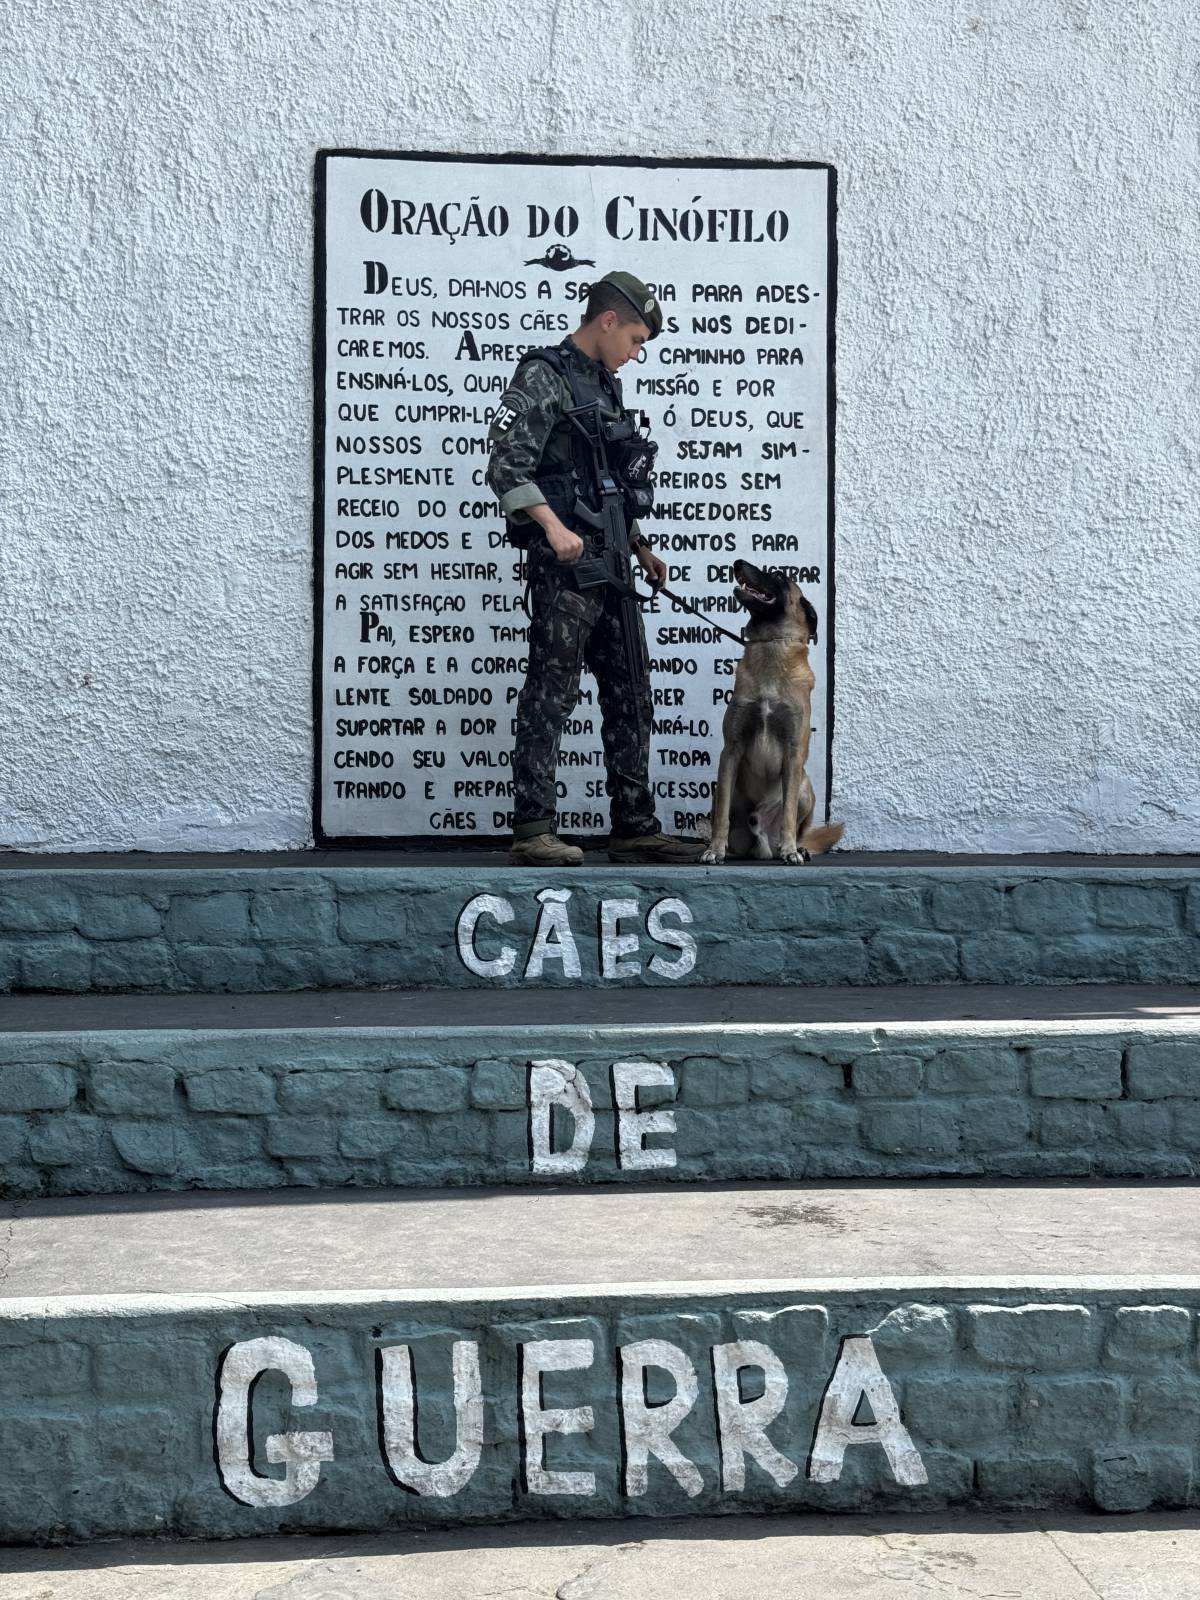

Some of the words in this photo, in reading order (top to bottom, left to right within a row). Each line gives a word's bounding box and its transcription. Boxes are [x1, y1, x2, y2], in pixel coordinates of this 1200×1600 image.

[360, 188, 509, 245] ORAÇÃO
[527, 204, 579, 238] DO
[605, 195, 789, 242] CINÓFILO
[363, 261, 438, 299] DEUS,
[449, 279, 526, 299] DAI-NOS
[538, 280, 551, 299] A
[692, 284, 742, 303] PARA
[756, 284, 820, 304] ADES-
[337, 308, 385, 326] TRAR
[397, 310, 420, 327] OS
[432, 311, 510, 329] NOSSOS
[520, 310, 568, 331] CÃES
[693, 317, 732, 334] NOS
[746, 317, 807, 334] DEDI-
[337, 340, 430, 360] CAREMOS.
[660, 347, 745, 365] CAMINHO
[757, 347, 804, 365] PARA
[337, 367, 454, 396] ENSINÁ-LOS,
[636, 372, 700, 396] MISSÃO
[713, 379, 722, 396] E
[737, 379, 775, 397] POR
[338, 403, 379, 422] QUE
[663, 404, 676, 427] Ó
[691, 407, 754, 432] DEUS,
[767, 410, 804, 429] QUE
[493, 405, 517, 431] PE
[336, 436, 422, 455] NOSSOS
[677, 440, 742, 460] SEJAM
[761, 442, 810, 460] SIM-
[336, 466, 455, 486] PLESMENTE
[741, 472, 781, 490] SEM
[338, 499, 400, 517] RECEIO
[418, 500, 446, 517] DO
[336, 531, 375, 549] DOS
[386, 532, 449, 550] MEDOS
[462, 532, 472, 549] E
[648, 533, 737, 552] PRONTOS
[752, 533, 799, 552] PARA
[336, 563, 373, 580] AGIR
[383, 563, 418, 580] SEM
[431, 562, 503, 584] HESITAR,
[669, 565, 692, 582] DE
[336, 594, 347, 611] A
[360, 612, 396, 647] PAI,
[409, 625, 474, 643] ESPERO
[656, 626, 722, 645] SENHOR
[334, 656, 346, 673] A
[358, 656, 415, 679] FORÇA
[427, 657, 437, 673] E
[447, 657, 458, 673] A
[336, 687, 390, 707] LENTE
[409, 687, 493, 706] SOLDADO
[335, 718, 425, 737] SUPORTAR
[436, 719, 447, 735] A
[460, 718, 497, 736] DOR
[334, 750, 394, 769] CENDO
[413, 750, 445, 769] SEU
[657, 749, 711, 767] TROPA
[334, 781, 406, 800] TRANDO
[425, 781, 435, 799] E
[455, 887, 698, 980] CÃES
[526, 1059, 677, 1175] DE
[212, 1333, 930, 1508] GUERRA
